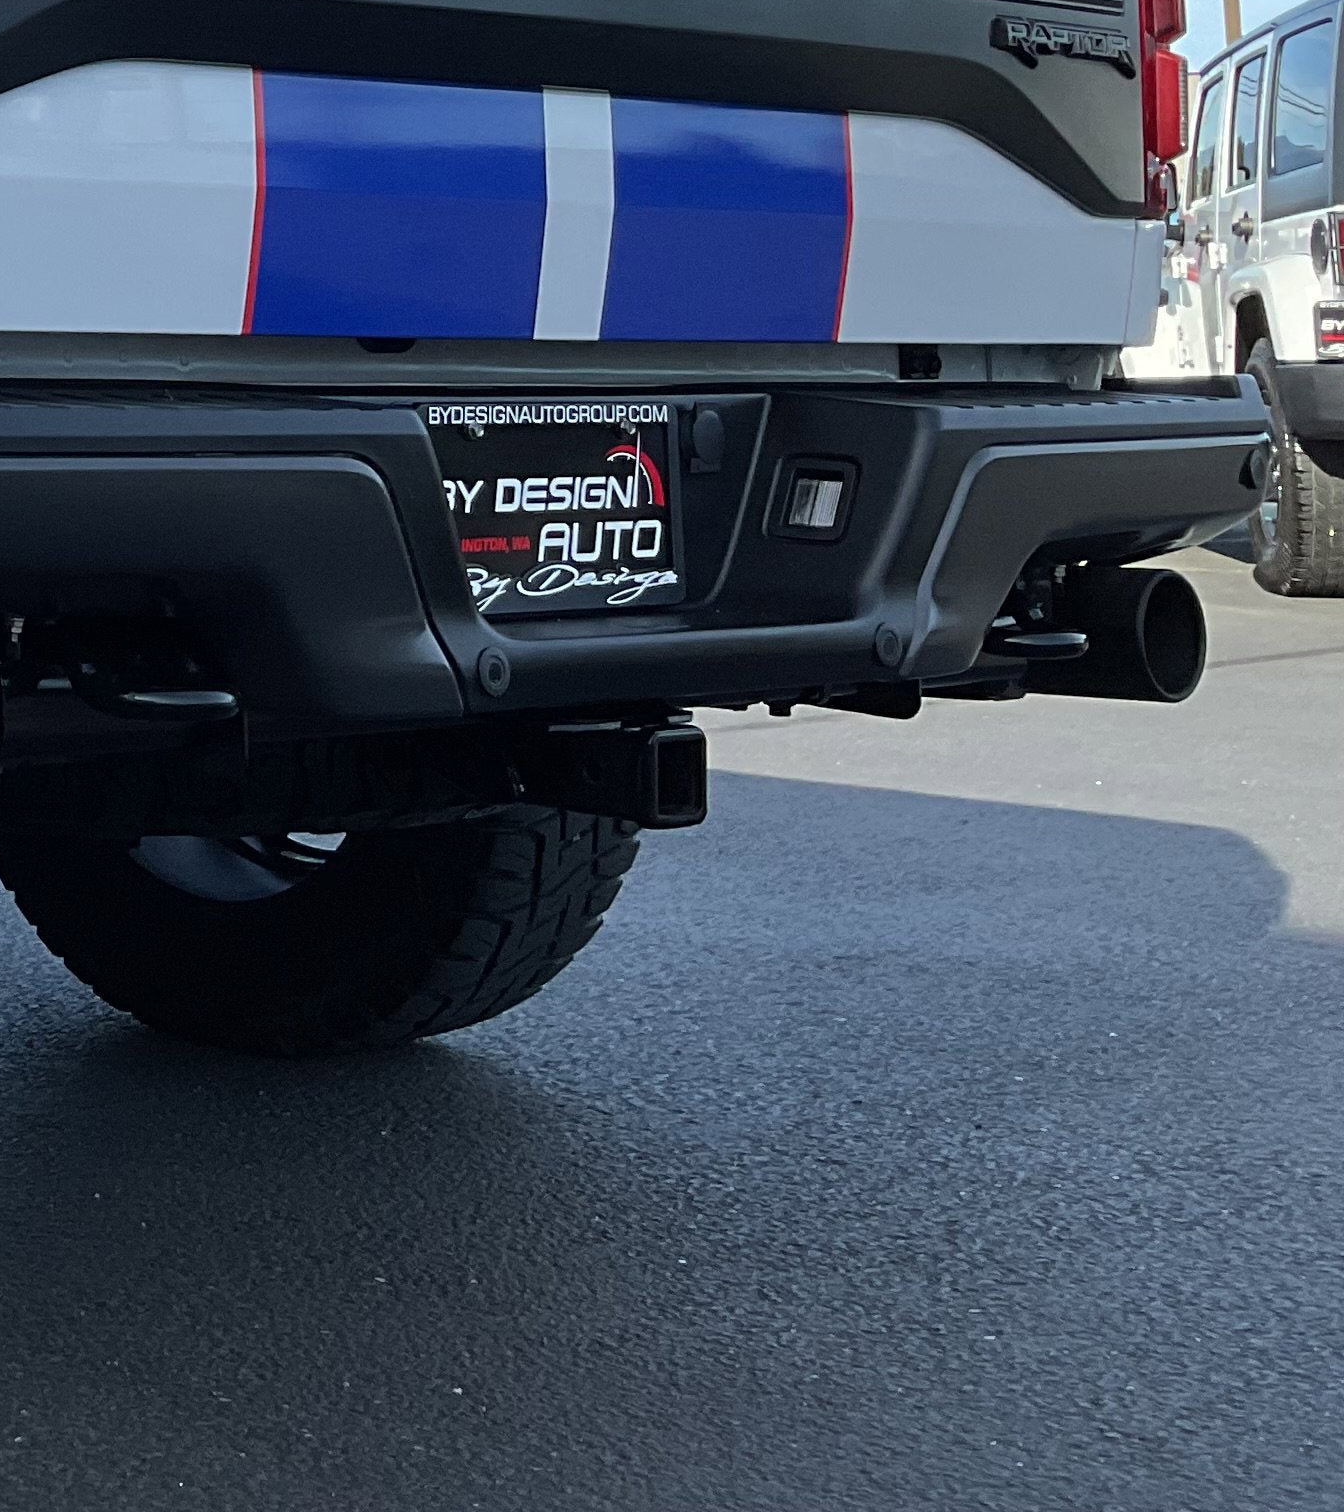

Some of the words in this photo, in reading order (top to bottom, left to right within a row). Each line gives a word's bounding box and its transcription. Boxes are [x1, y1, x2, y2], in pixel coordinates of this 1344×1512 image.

[991, 15, 1136, 79] RAPTOR
[428, 405, 668, 424] BYDESIGNAUTOGROUPCOM
[494, 476, 635, 512] DESIGN
[538, 519, 663, 562] AUTO
